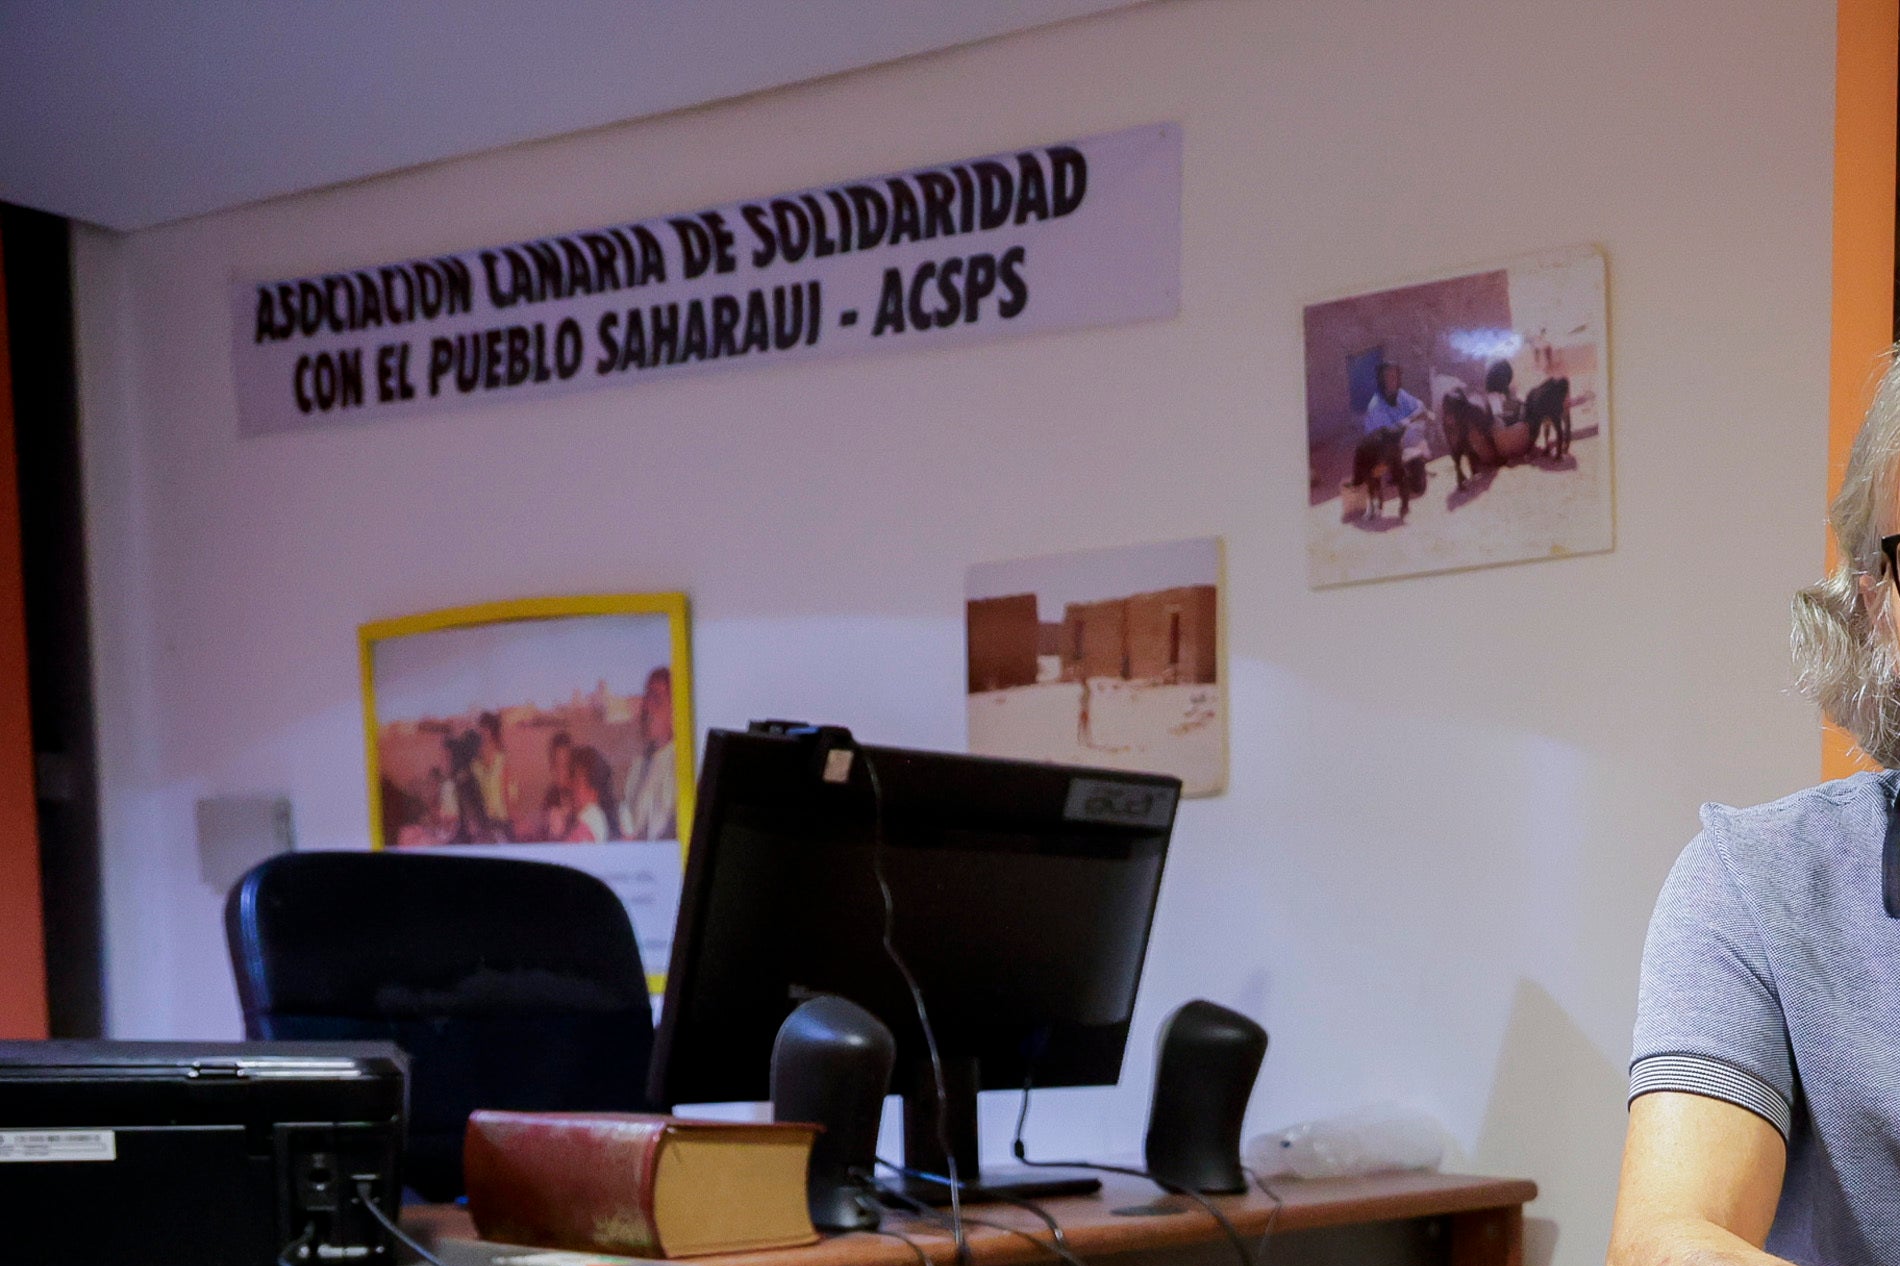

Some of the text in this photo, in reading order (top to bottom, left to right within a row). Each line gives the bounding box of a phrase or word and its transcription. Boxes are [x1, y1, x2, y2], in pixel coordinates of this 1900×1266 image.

[257, 146, 1087, 343] ASOCIACION CANARIA DE SOLIDARIDAD
[294, 246, 1028, 413] CON EL PUEBLO SAHARAUI - ACSPS
